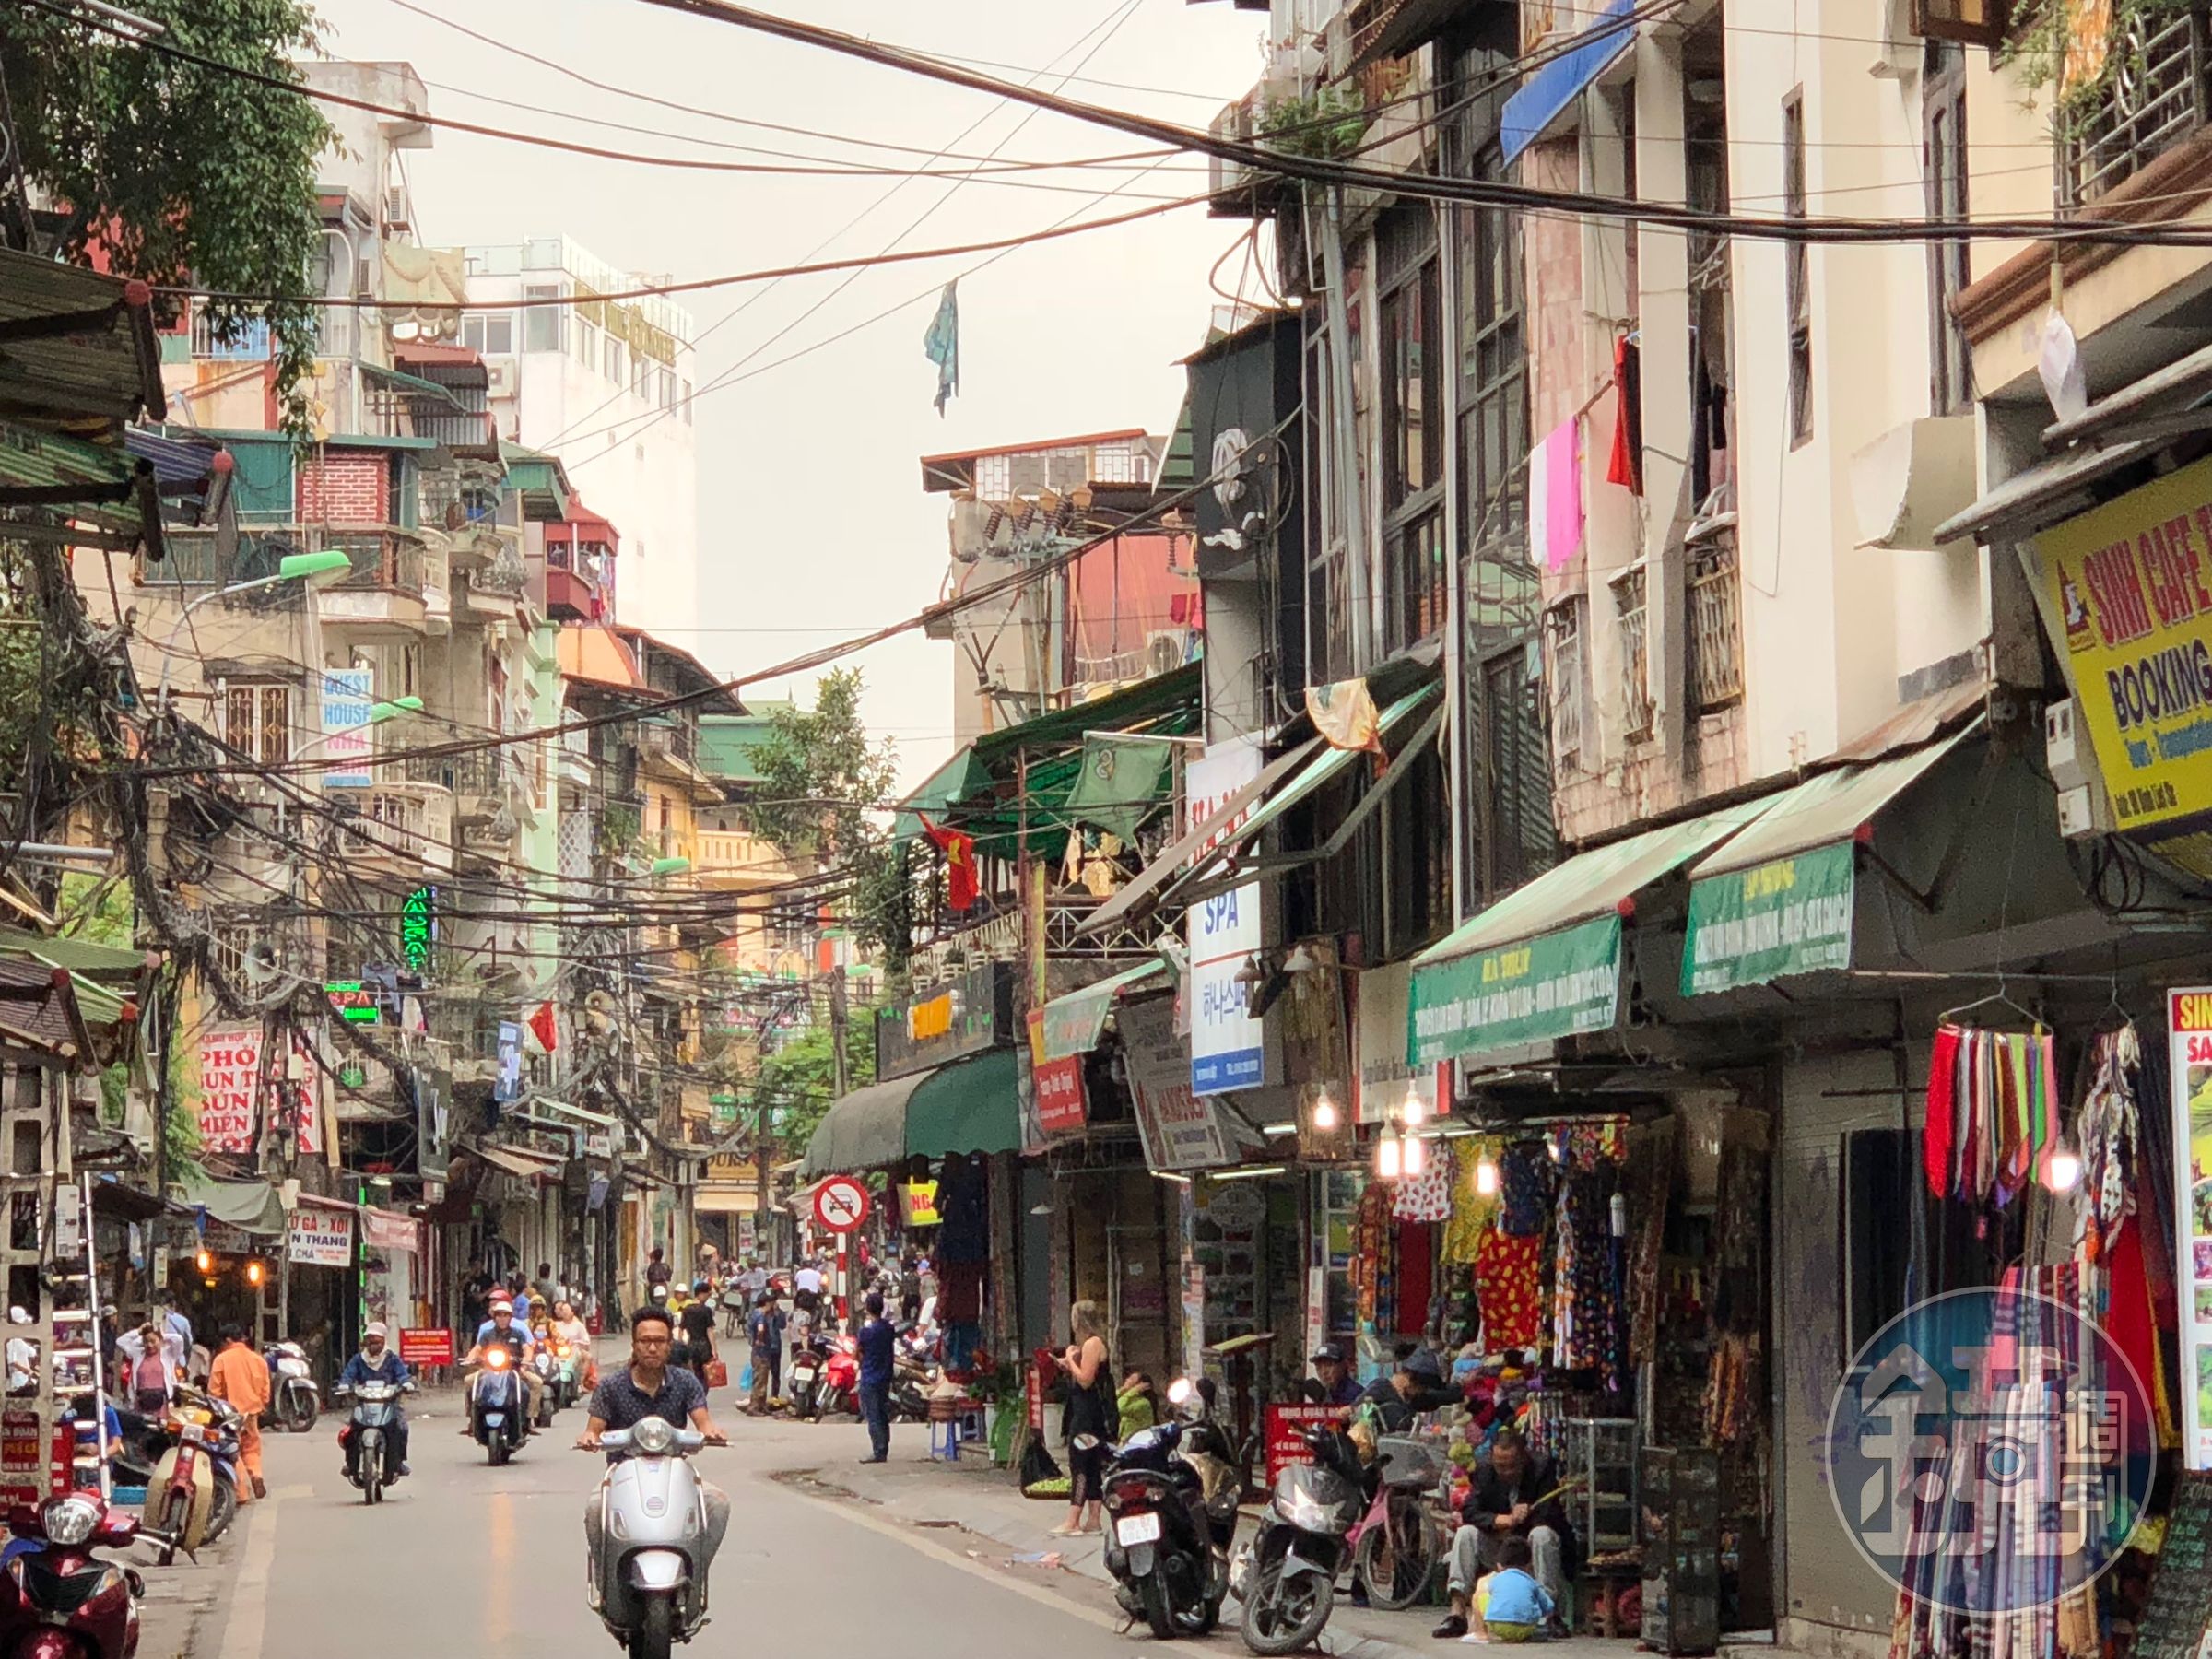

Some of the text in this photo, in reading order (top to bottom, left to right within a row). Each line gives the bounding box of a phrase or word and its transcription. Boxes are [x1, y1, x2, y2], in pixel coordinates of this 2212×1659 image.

[2138, 514, 2211, 628] CAFE
[2106, 639, 2212, 731] BOOKING
[1205, 888, 1239, 935] SPA
